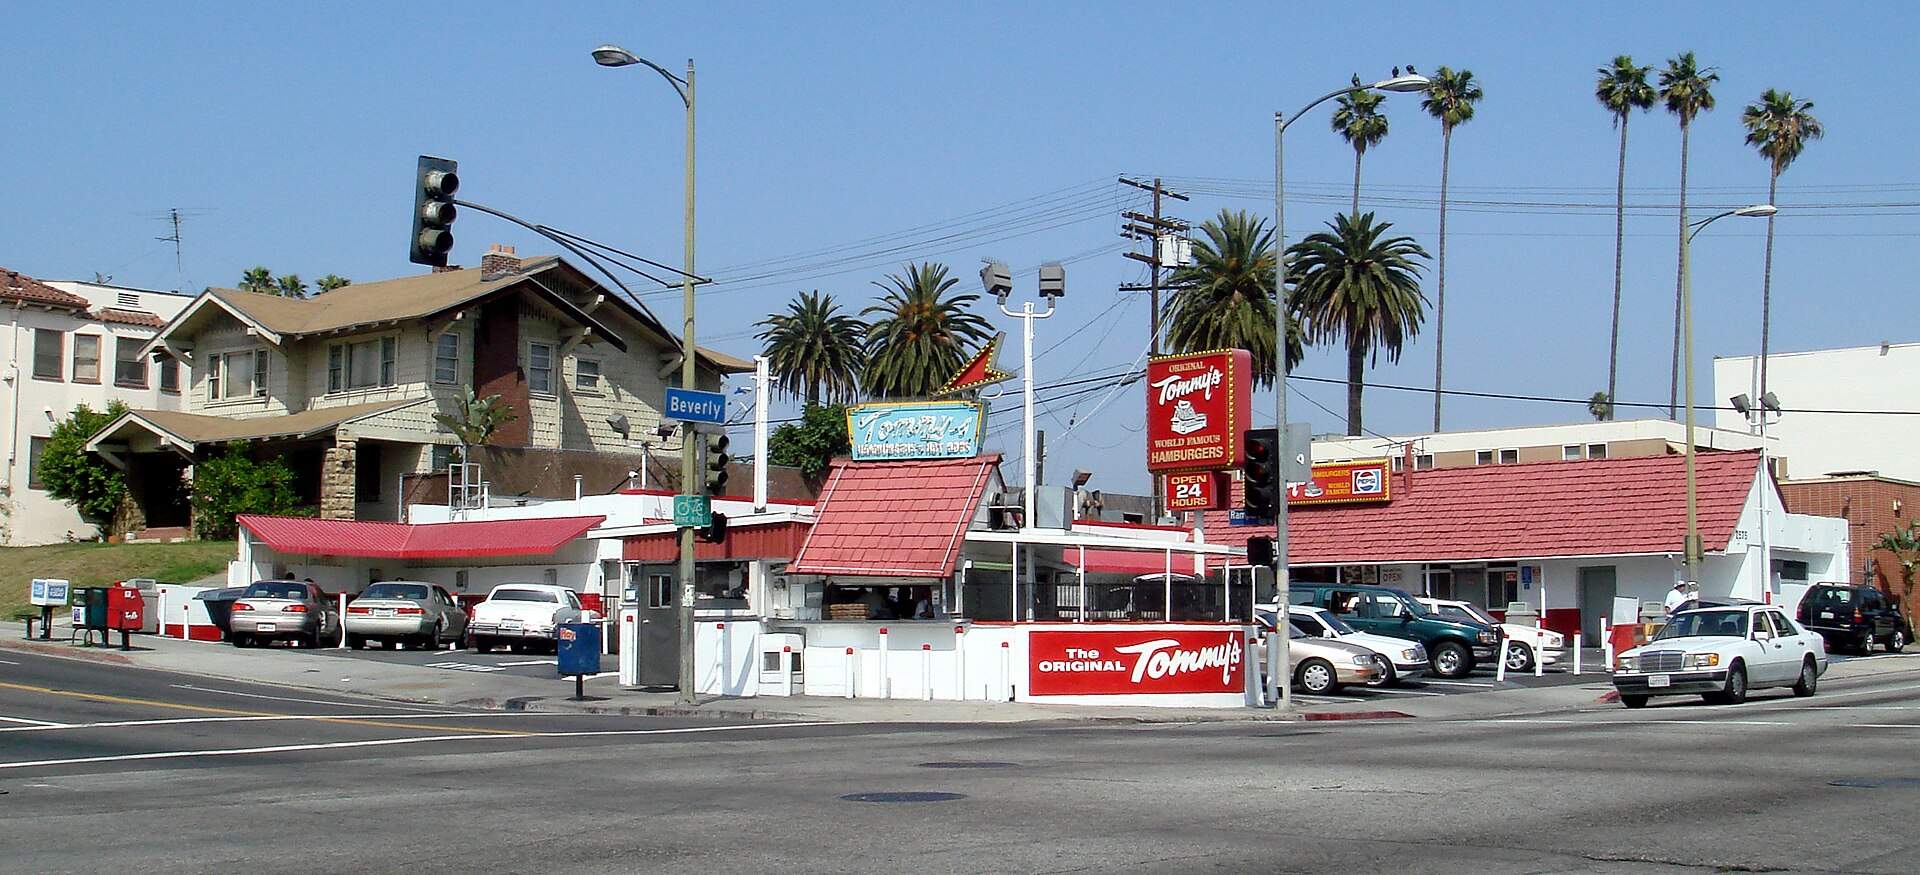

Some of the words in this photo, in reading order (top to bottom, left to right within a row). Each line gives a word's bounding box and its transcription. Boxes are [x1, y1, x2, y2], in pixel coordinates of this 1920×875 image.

[1168, 361, 1205, 372] ORIGINAL
[1150, 365, 1223, 405] Tommy's
[670, 396, 721, 420] Beverly
[1154, 438, 1185, 448] WORLD
[1186, 435, 1221, 446] FAMOUS
[1151, 446, 1224, 463] HAMBURGERS
[1171, 475, 1207, 484] OPEN
[1176, 484, 1202, 499] 24
[1171, 497, 1208, 507] HOURS
[1038, 660, 1127, 672] ORIGINAL
[1114, 631, 1243, 686] Tommy's
[1066, 648, 1100, 659] The
